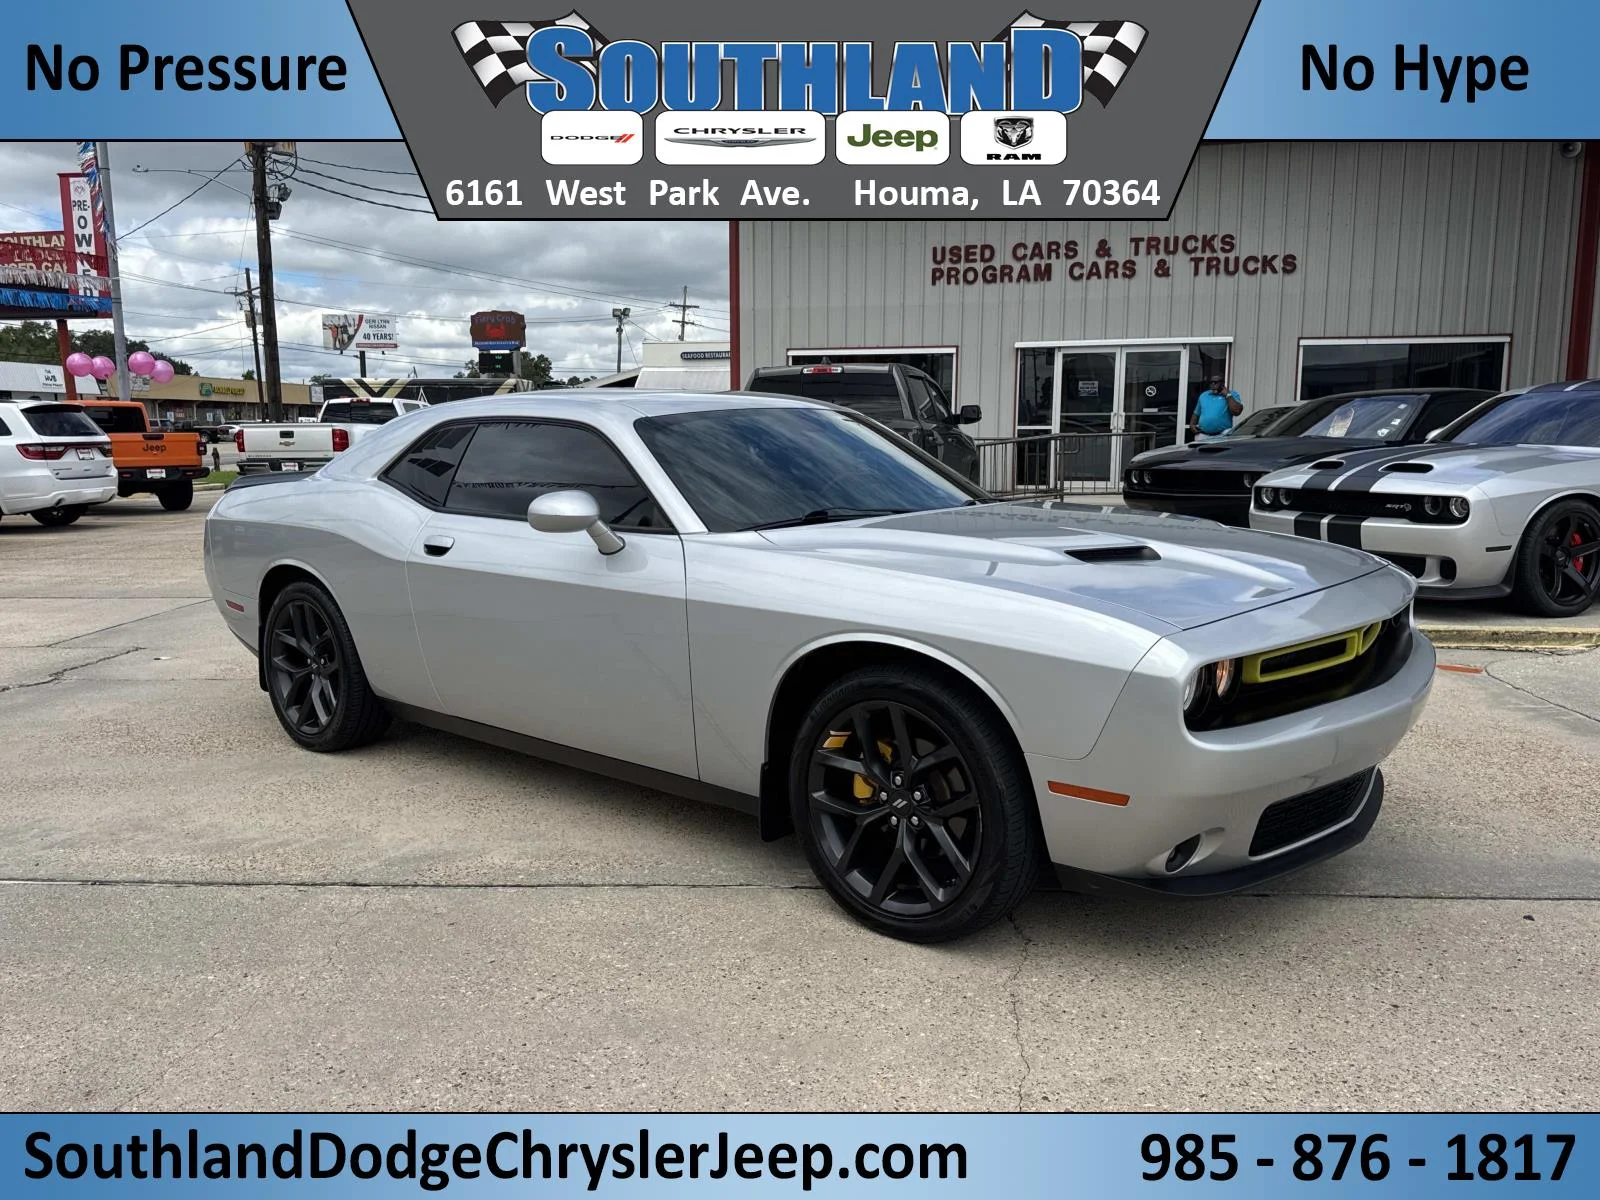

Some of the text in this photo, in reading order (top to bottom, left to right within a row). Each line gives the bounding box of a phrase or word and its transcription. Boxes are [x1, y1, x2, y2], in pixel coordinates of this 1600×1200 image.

[72, 200, 90, 211] PRE-
[932, 233, 1236, 265] USED CARS & TRUCKS
[931, 253, 1298, 286] PROGRAM CARS & TRUCKS
[362, 333, 394, 341] 40 YEARS!
[142, 443, 167, 452] Jeep
